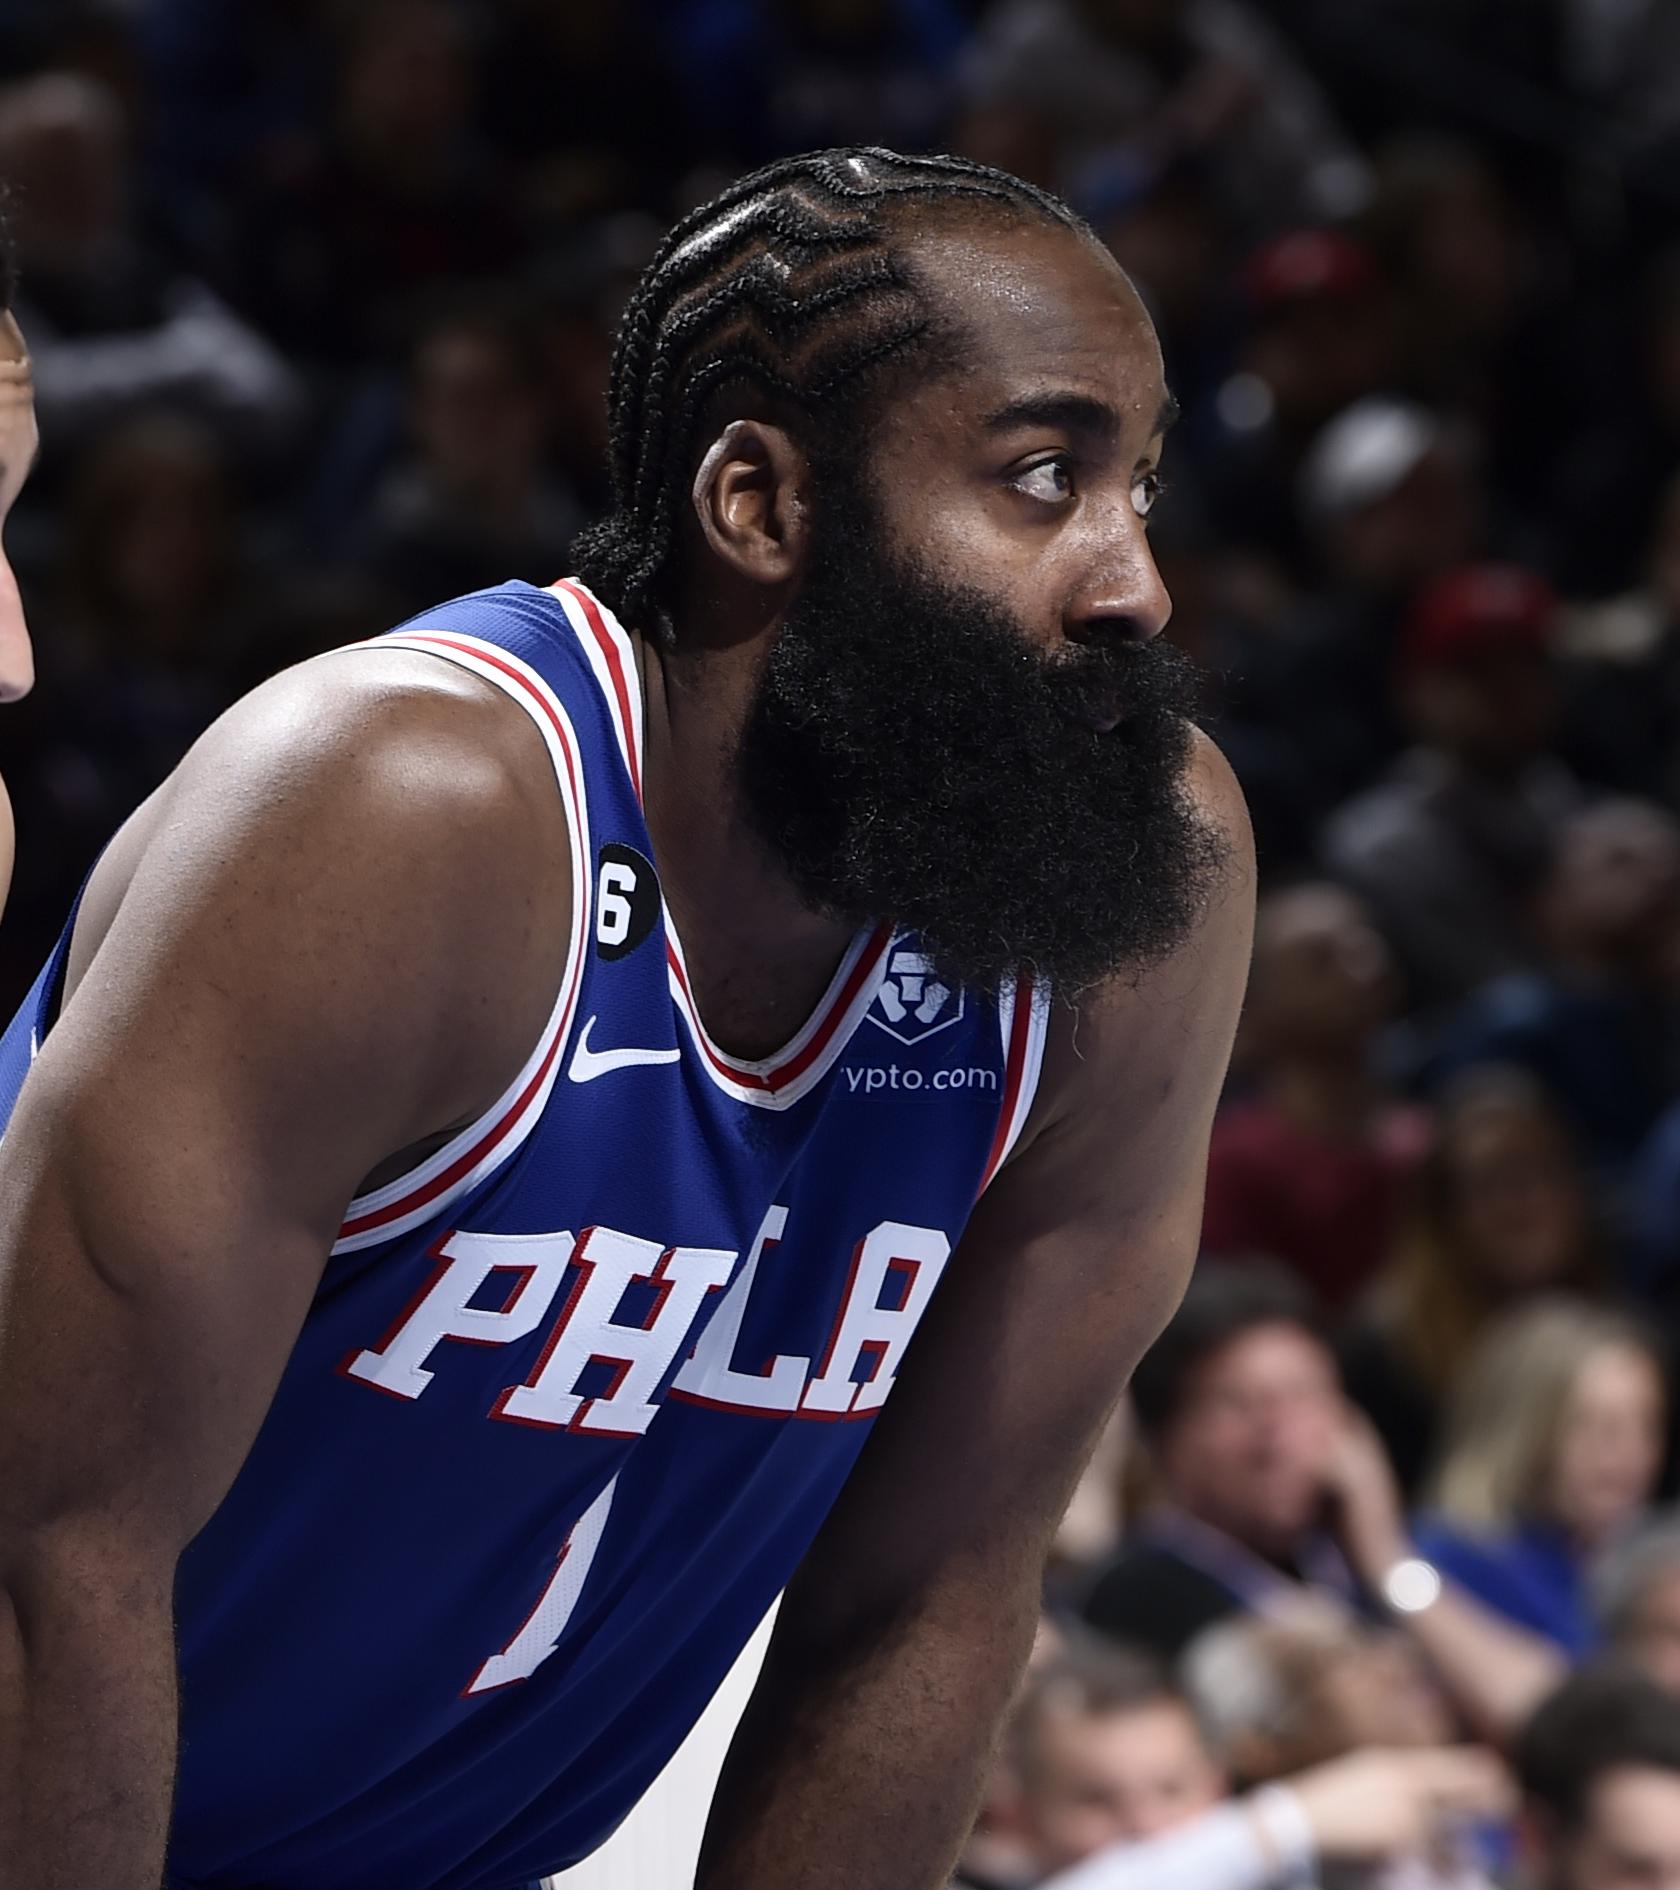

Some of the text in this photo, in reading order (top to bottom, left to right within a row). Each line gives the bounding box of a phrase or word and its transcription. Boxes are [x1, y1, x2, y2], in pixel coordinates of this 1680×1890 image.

[597, 861, 637, 946] 6
[840, 1063, 998, 1094] ypto.com
[335, 1204, 952, 1440] PHLA
[458, 1467, 622, 1698] 1
